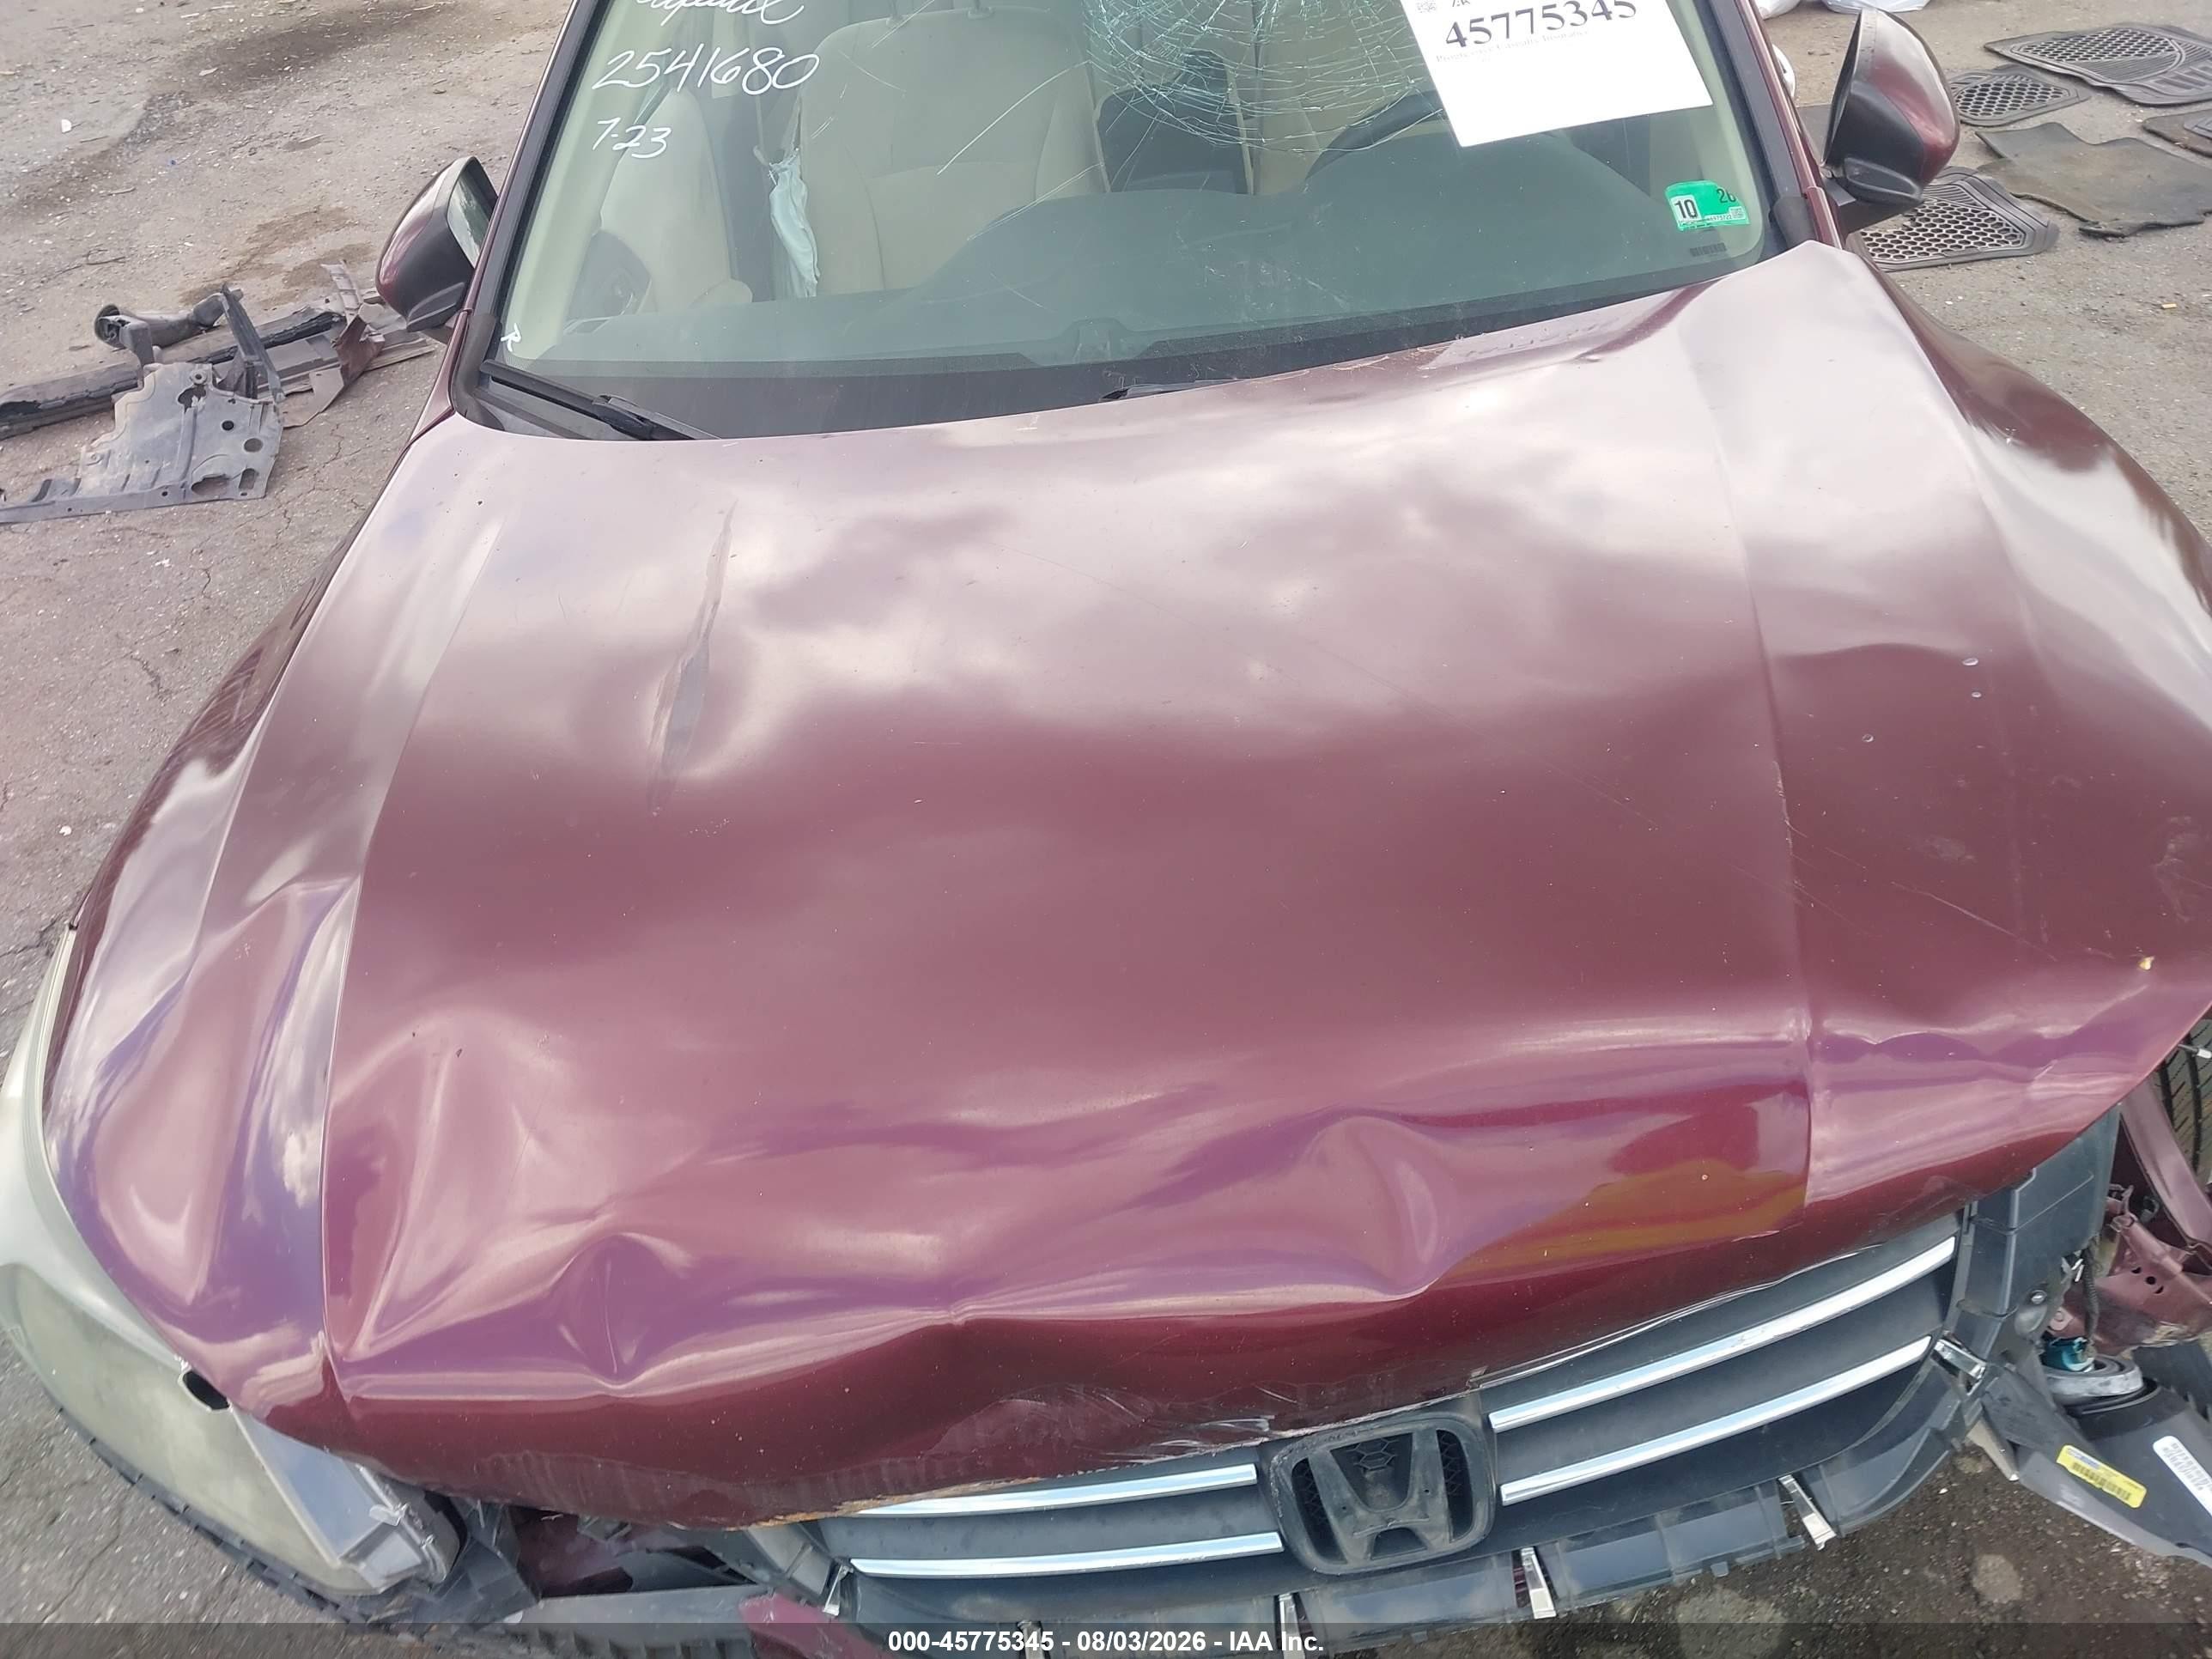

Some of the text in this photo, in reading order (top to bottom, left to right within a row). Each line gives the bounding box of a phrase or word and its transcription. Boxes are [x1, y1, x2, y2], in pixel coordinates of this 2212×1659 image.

[1446, 0, 1636, 47] 45775345
[592, 44, 819, 94] 2541680
[593, 118, 672, 158] 7-23
[1674, 199, 1698, 218] 10
